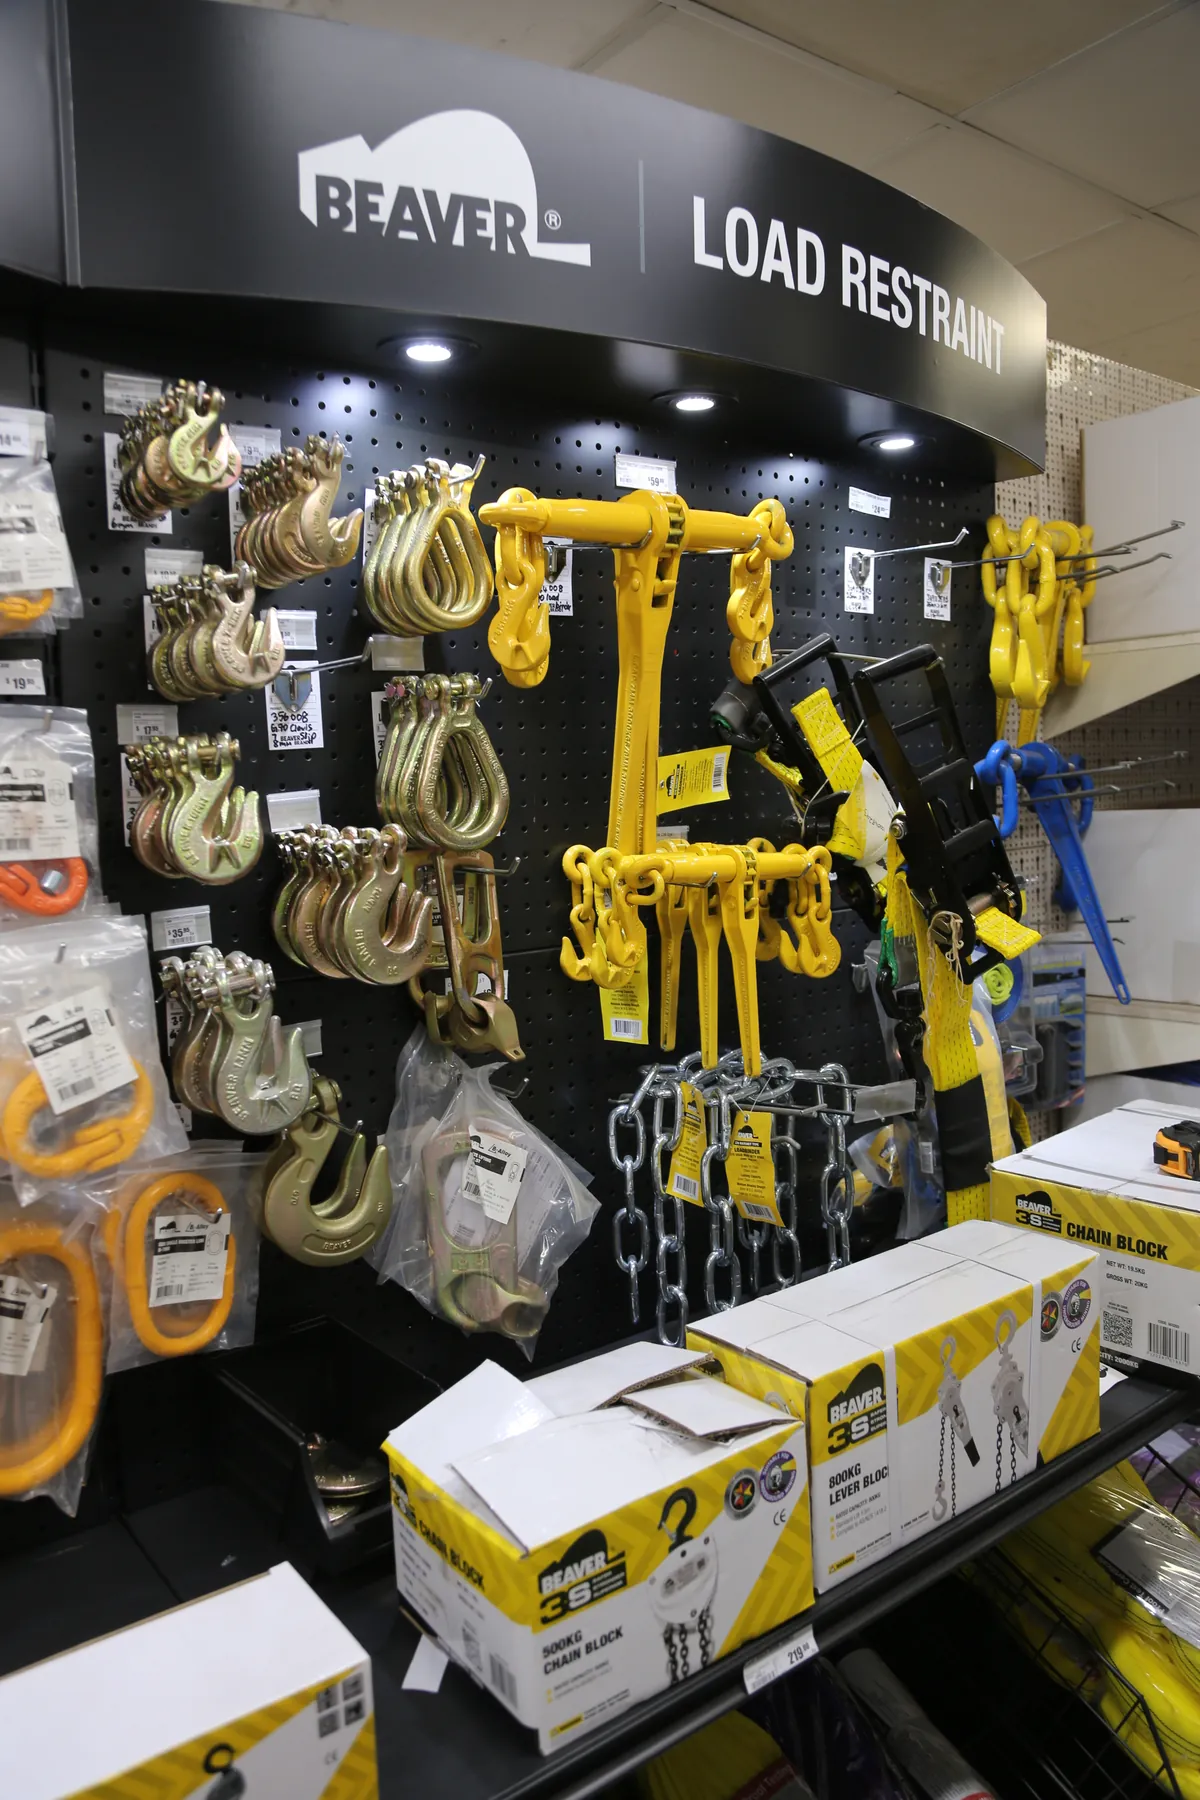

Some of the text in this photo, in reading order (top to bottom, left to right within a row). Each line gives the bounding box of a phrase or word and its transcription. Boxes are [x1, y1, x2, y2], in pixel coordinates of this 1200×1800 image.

[314, 174, 532, 257] BEAVER
[693, 195, 1005, 375] LOAD RESTRAINT
[224, 1073, 250, 1120] BEAVER
[1016, 1198, 1051, 1216] BEAVER
[1066, 1222, 1168, 1261] CHAIN BLOCK
[1106, 1259, 1146, 1275] NET WT: 19.5KG
[1106, 1272, 1148, 1289] GROSS WT: 20KG
[1114, 1353, 1139, 1369] 2000KG
[830, 1386, 882, 1425] BEAVER
[828, 1462, 861, 1489] 800KG
[829, 1463, 889, 1506] LEVER BLOC
[450, 1548, 485, 1592] BLOCK
[541, 1550, 606, 1595] BEAVER
[542, 1628, 583, 1659] 500KG
[543, 1625, 624, 1676] CHAIN BLOCK
[787, 1645, 804, 1665] 219
